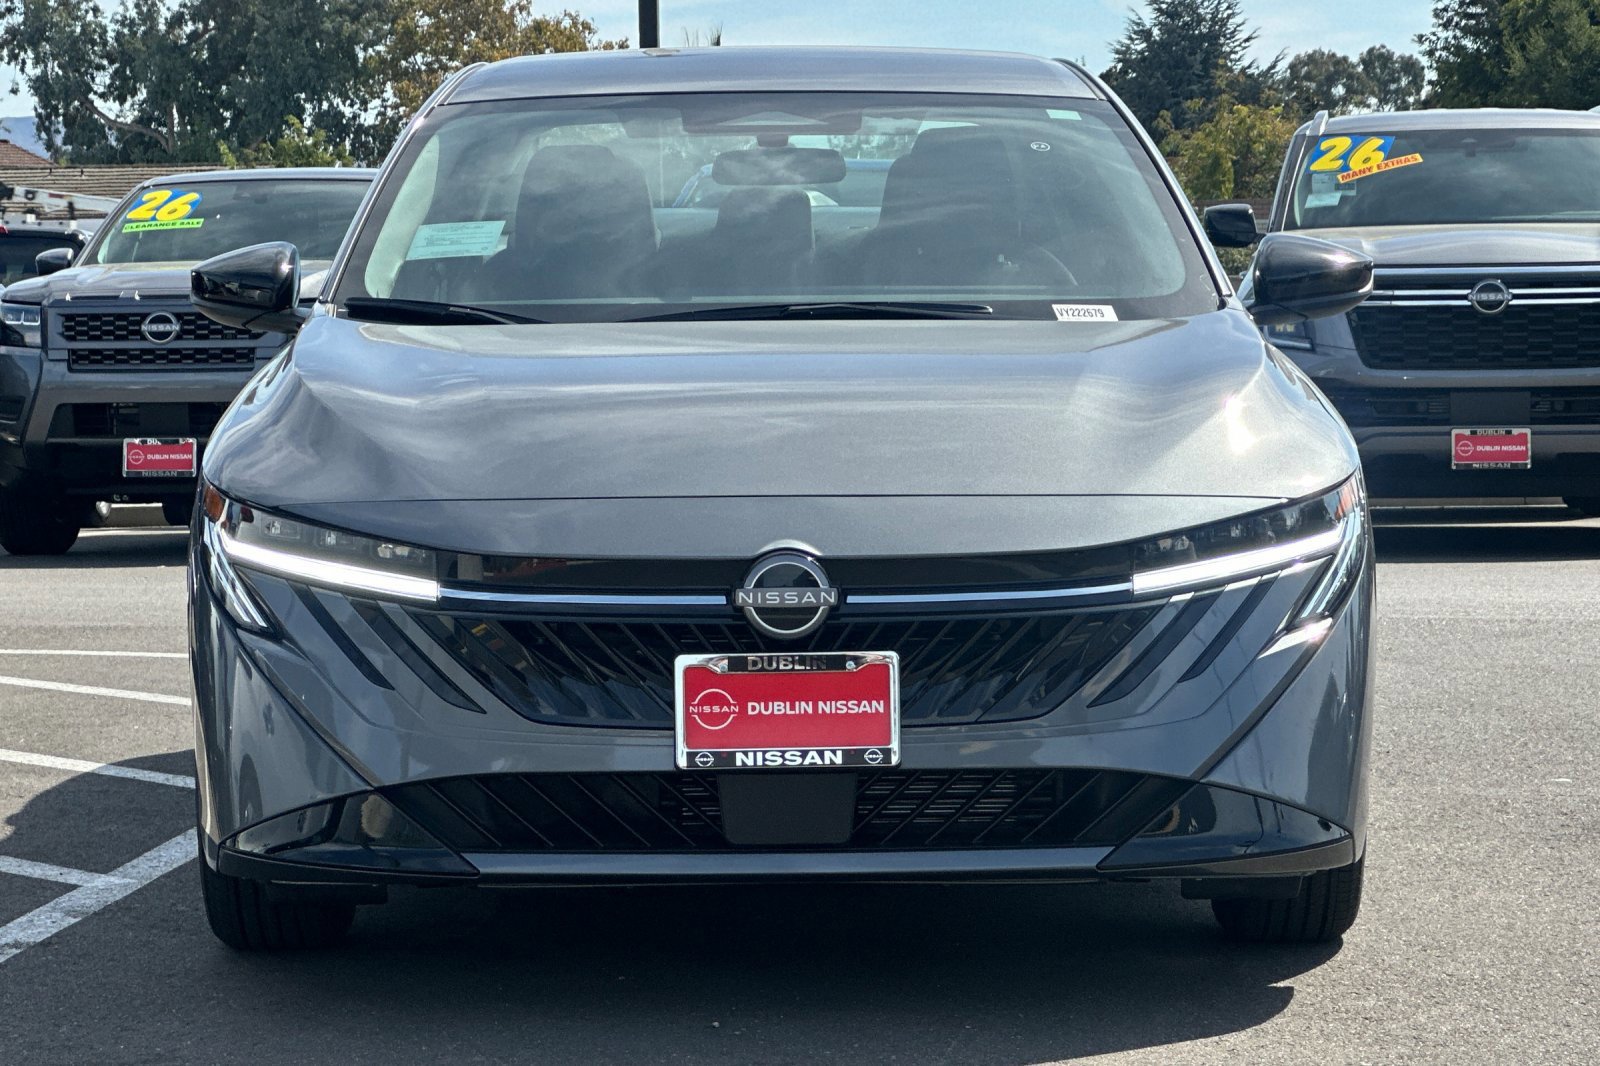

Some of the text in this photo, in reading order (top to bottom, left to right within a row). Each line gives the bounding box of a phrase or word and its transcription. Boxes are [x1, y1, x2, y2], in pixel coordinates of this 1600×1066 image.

[1309, 136, 1385, 171] 26
[1341, 154, 1418, 181] MANY EXTRAS
[126, 190, 200, 221] 26
[124, 221, 178, 231] CLEARANCE
[1468, 292, 1512, 300] NISSAN
[738, 591, 835, 604] NISSAN
[747, 655, 827, 671] DUBLIN
[689, 705, 739, 713] NISSAN
[747, 700, 885, 715] DUBLIN NISSAN
[735, 750, 843, 767] NISSAN
